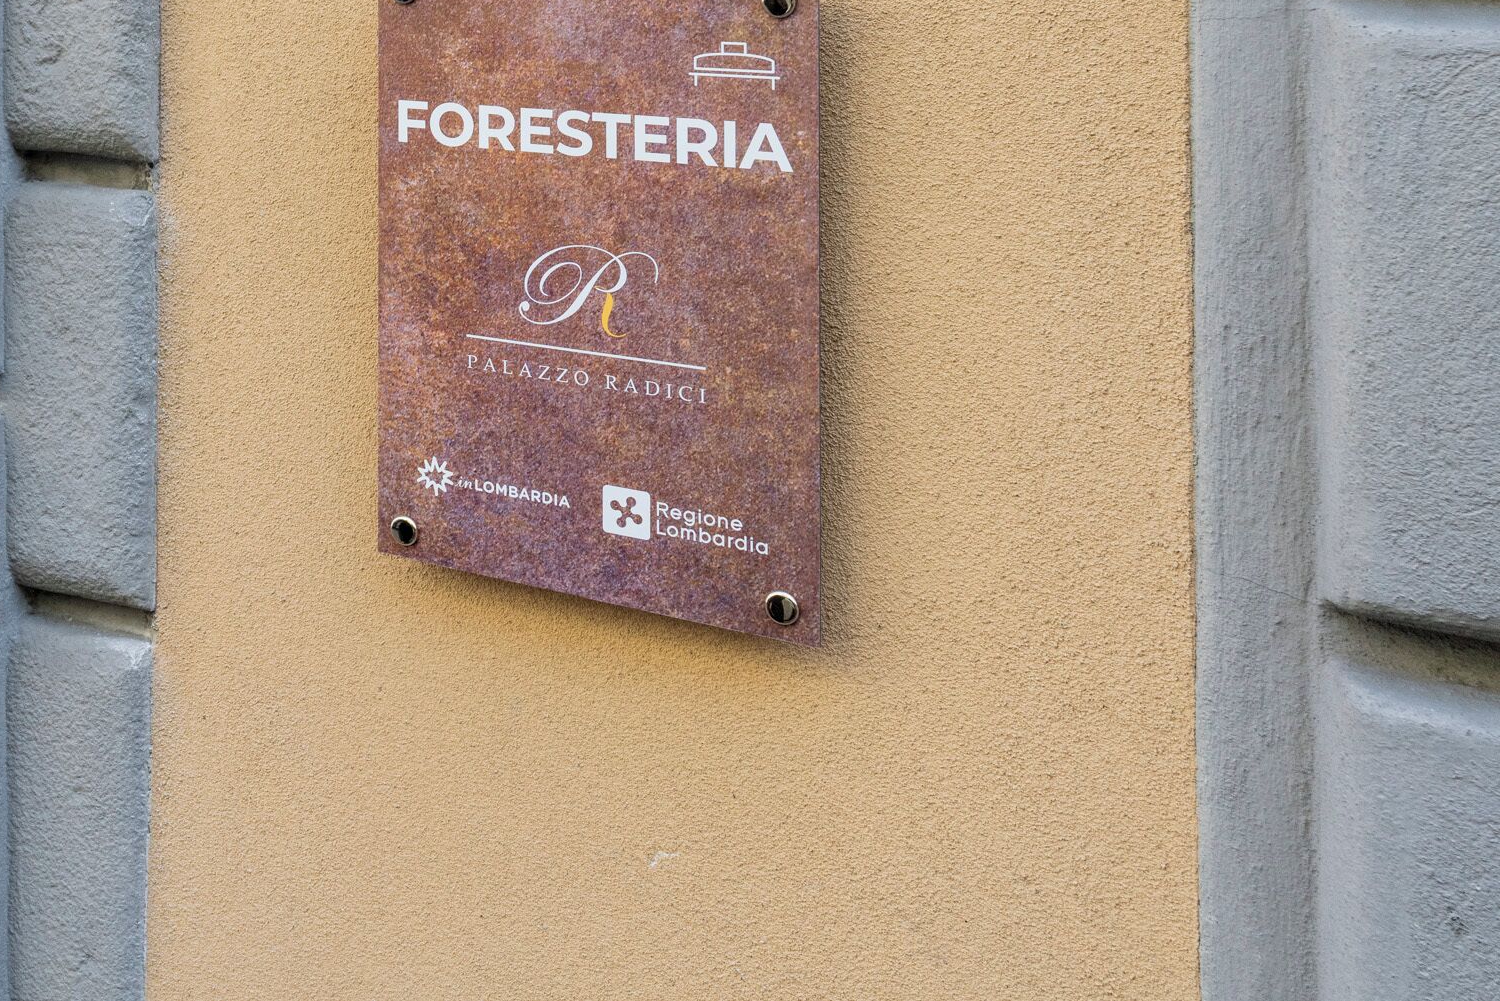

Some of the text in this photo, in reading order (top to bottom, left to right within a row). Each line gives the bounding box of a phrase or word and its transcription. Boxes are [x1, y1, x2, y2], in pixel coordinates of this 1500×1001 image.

[397, 99, 794, 173] FORESTERIA
[467, 354, 707, 404] PALAZZO RADICI
[655, 501, 743, 532] Regione
[655, 519, 769, 556] Lombardia
